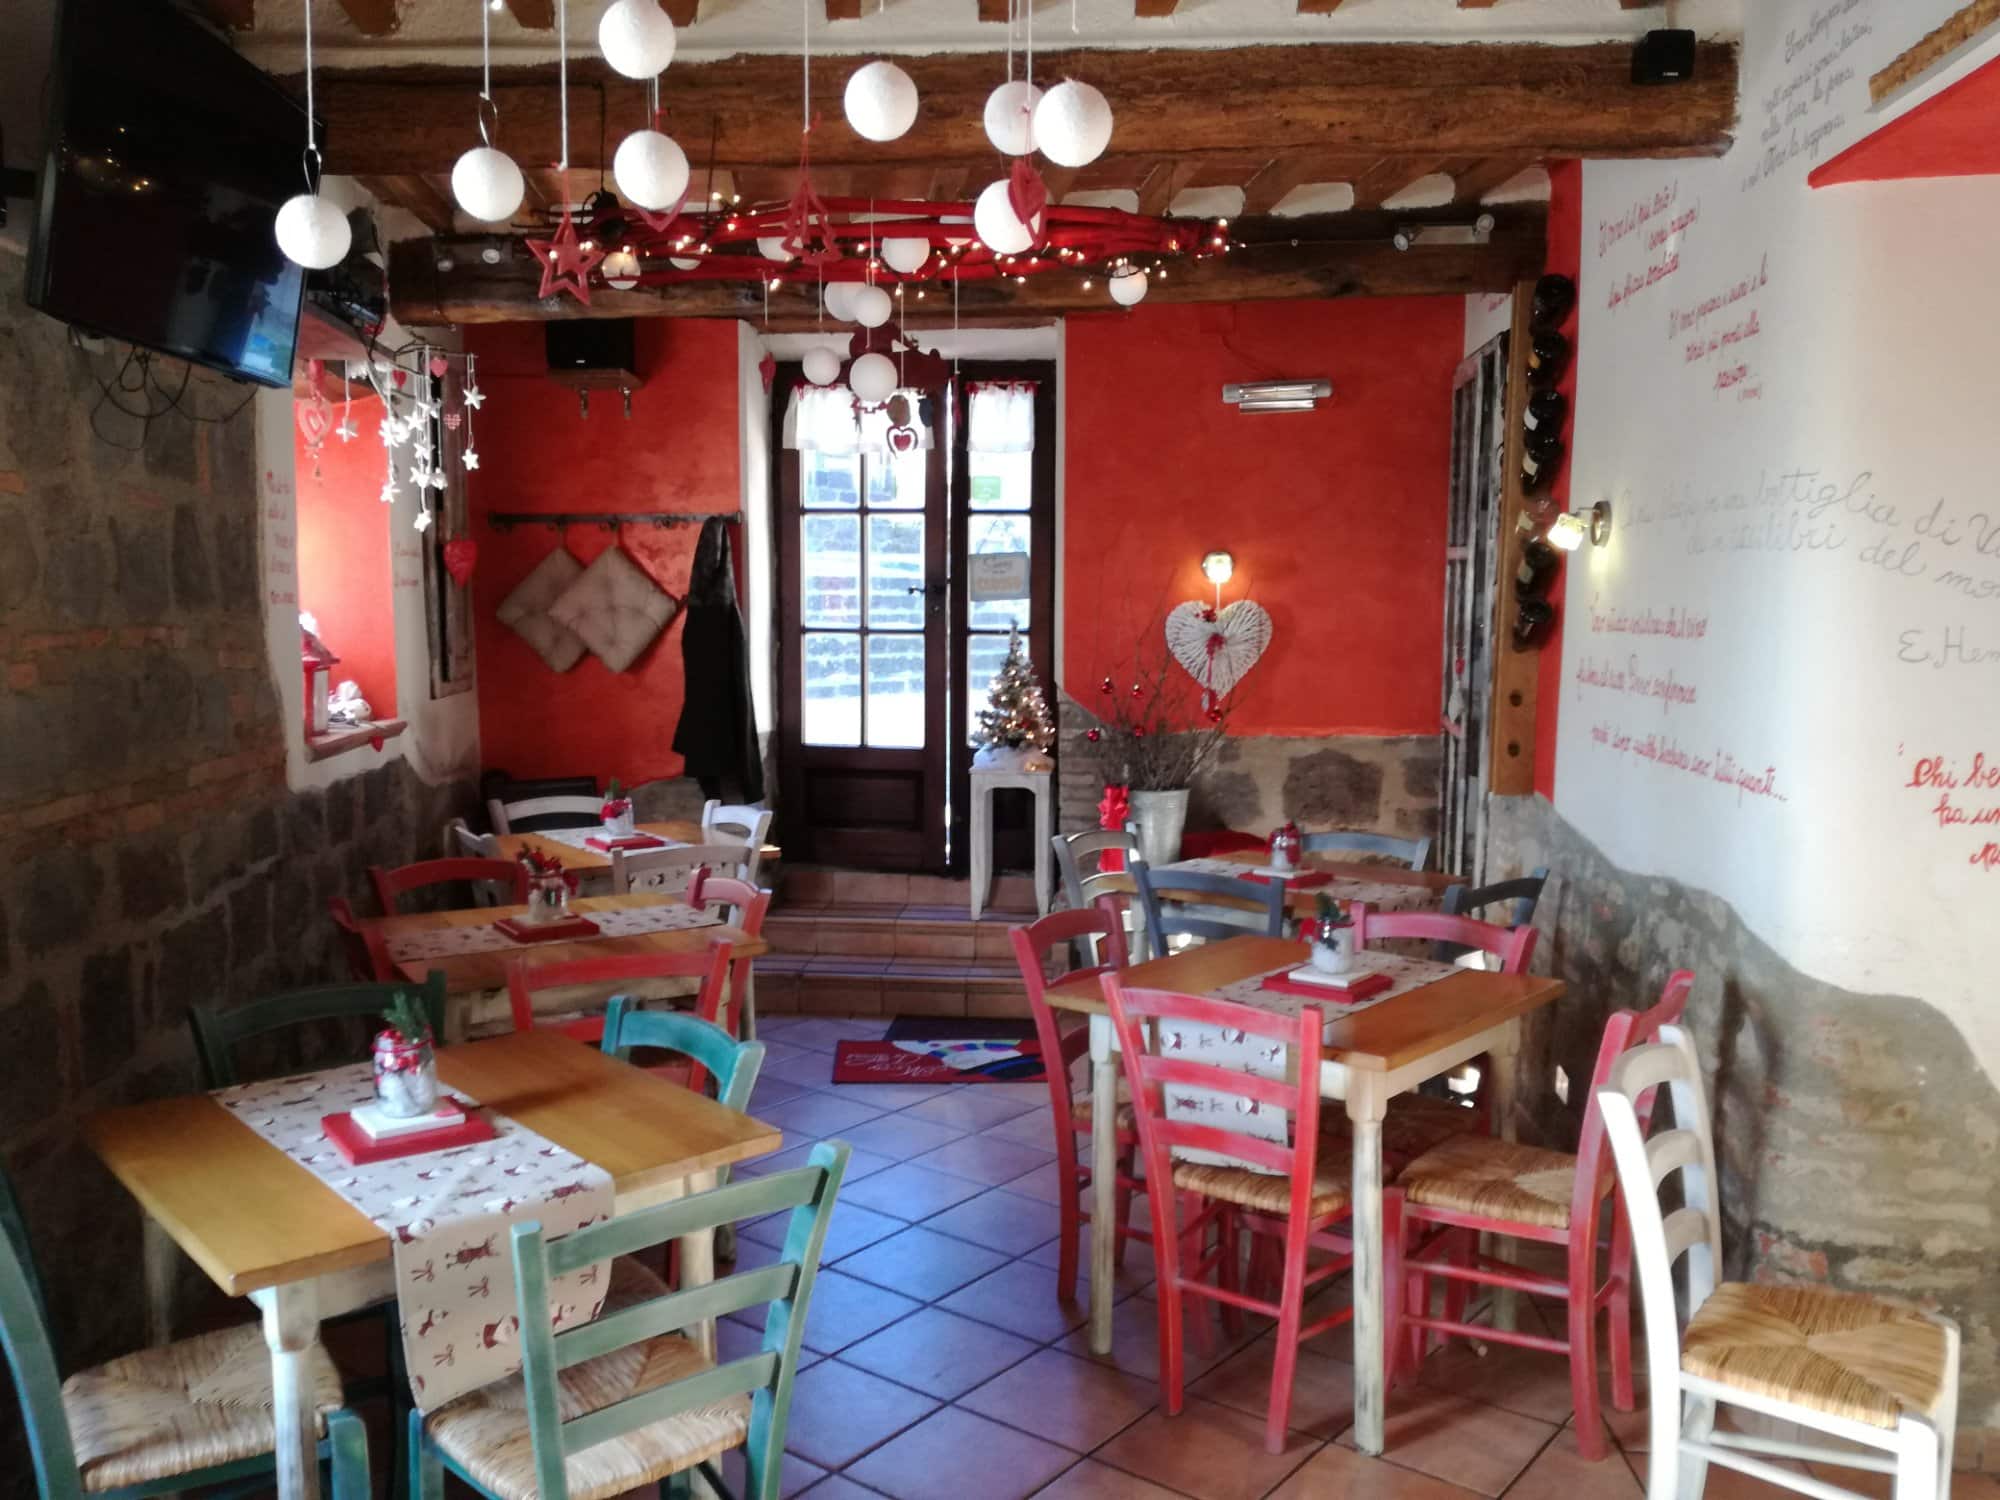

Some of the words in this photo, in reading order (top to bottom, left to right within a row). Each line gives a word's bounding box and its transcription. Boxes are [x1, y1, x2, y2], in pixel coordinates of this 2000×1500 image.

[1914, 497, 1962, 546] di
[1857, 536, 1927, 577] del
[1933, 569, 2000, 600] mo
[1904, 755, 1958, 789] Chi
